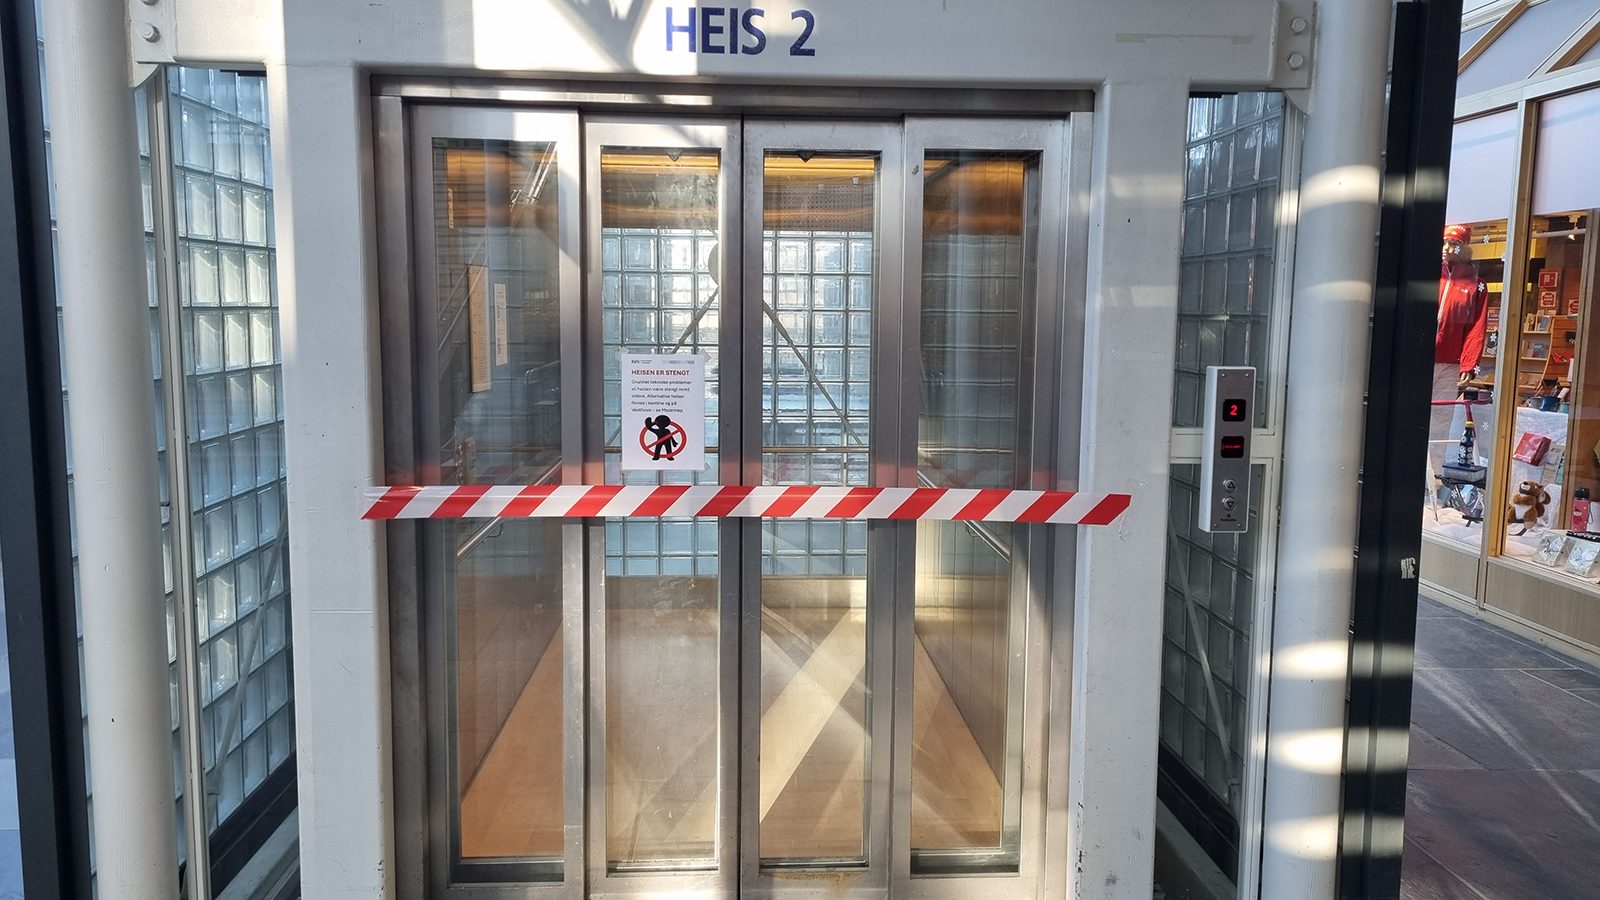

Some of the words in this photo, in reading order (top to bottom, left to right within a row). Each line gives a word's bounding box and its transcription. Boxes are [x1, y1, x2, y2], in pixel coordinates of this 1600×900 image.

[665, 7, 767, 55] HEIS
[789, 9, 816, 56] 2
[1230, 404, 1238, 416] 2
